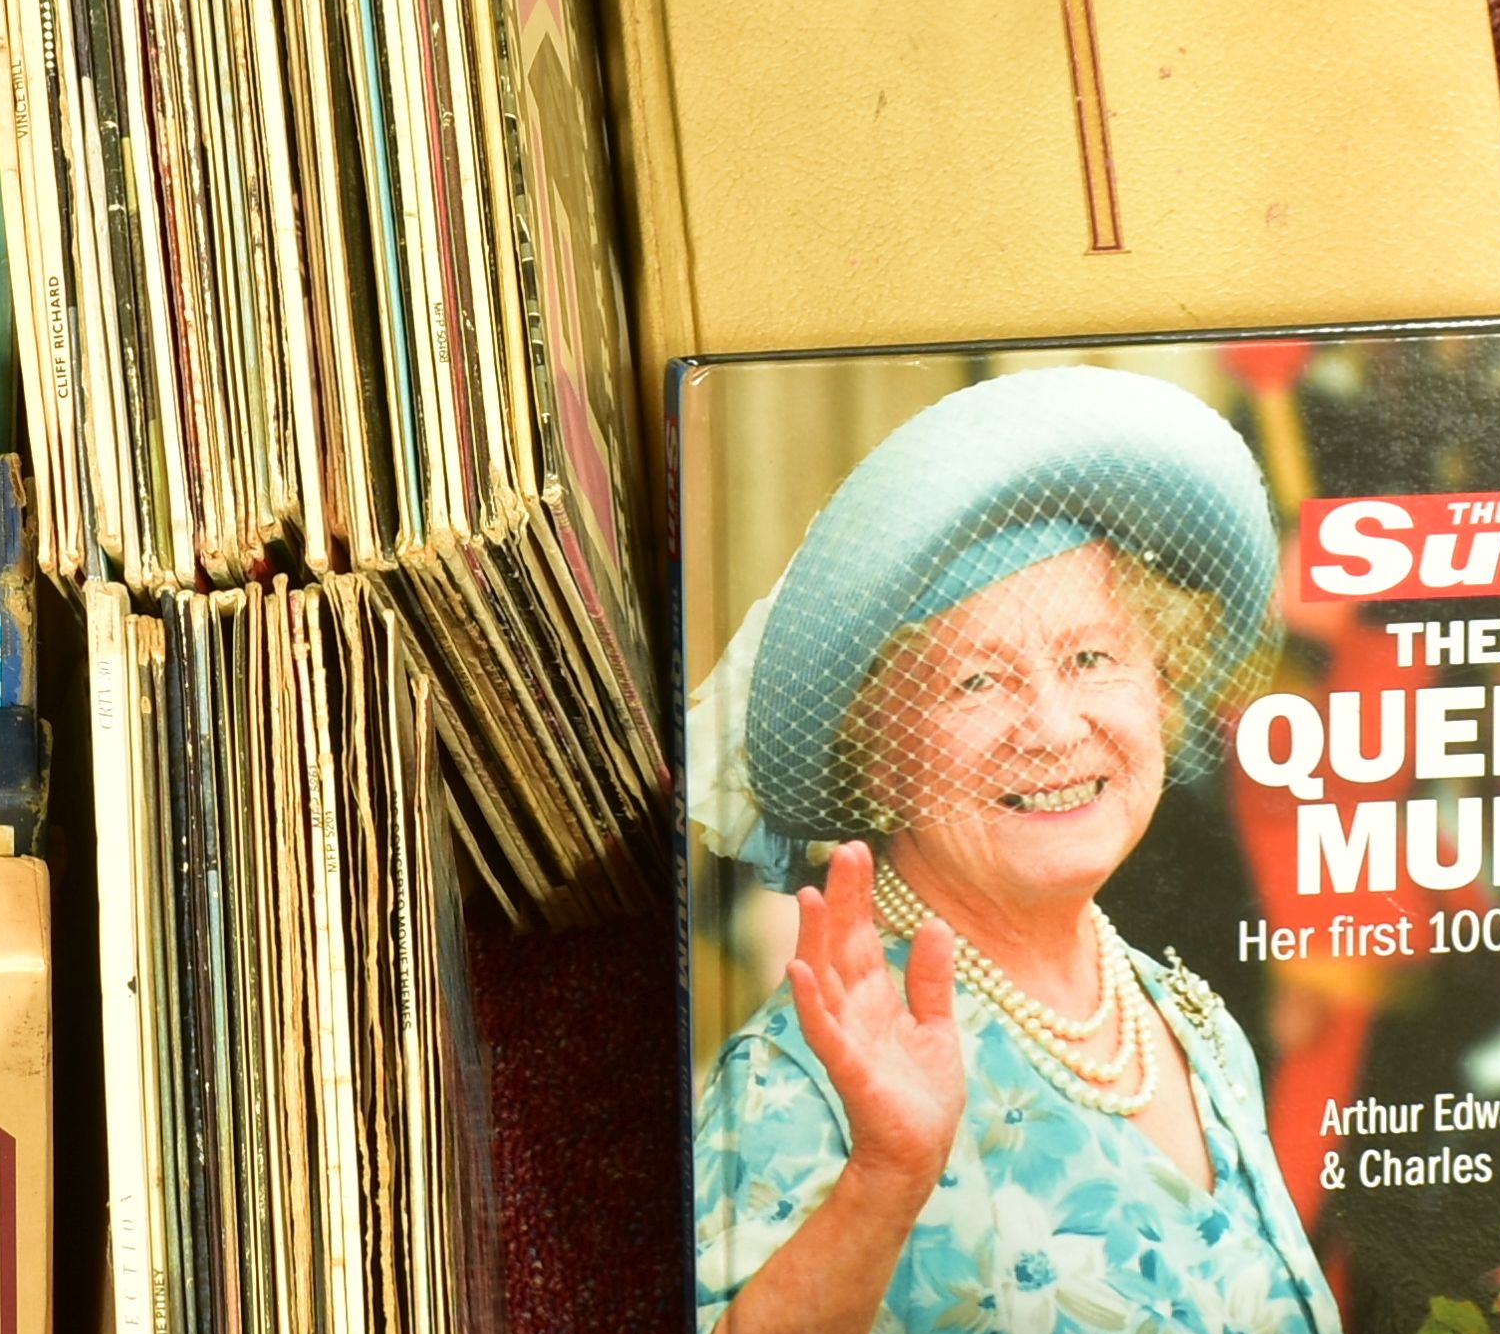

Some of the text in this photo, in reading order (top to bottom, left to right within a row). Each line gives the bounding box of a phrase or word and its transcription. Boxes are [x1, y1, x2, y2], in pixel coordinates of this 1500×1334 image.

[48, 275, 70, 398] CLIFF RICHARD
[1237, 919, 1314, 962] Her
[1328, 915, 1413, 958] first
[1319, 1097, 1423, 1136] Arthur
[1319, 1150, 1346, 1190] &
[1359, 1146, 1492, 1188] Charles
[152, 1267, 168, 1318] PITNEY
